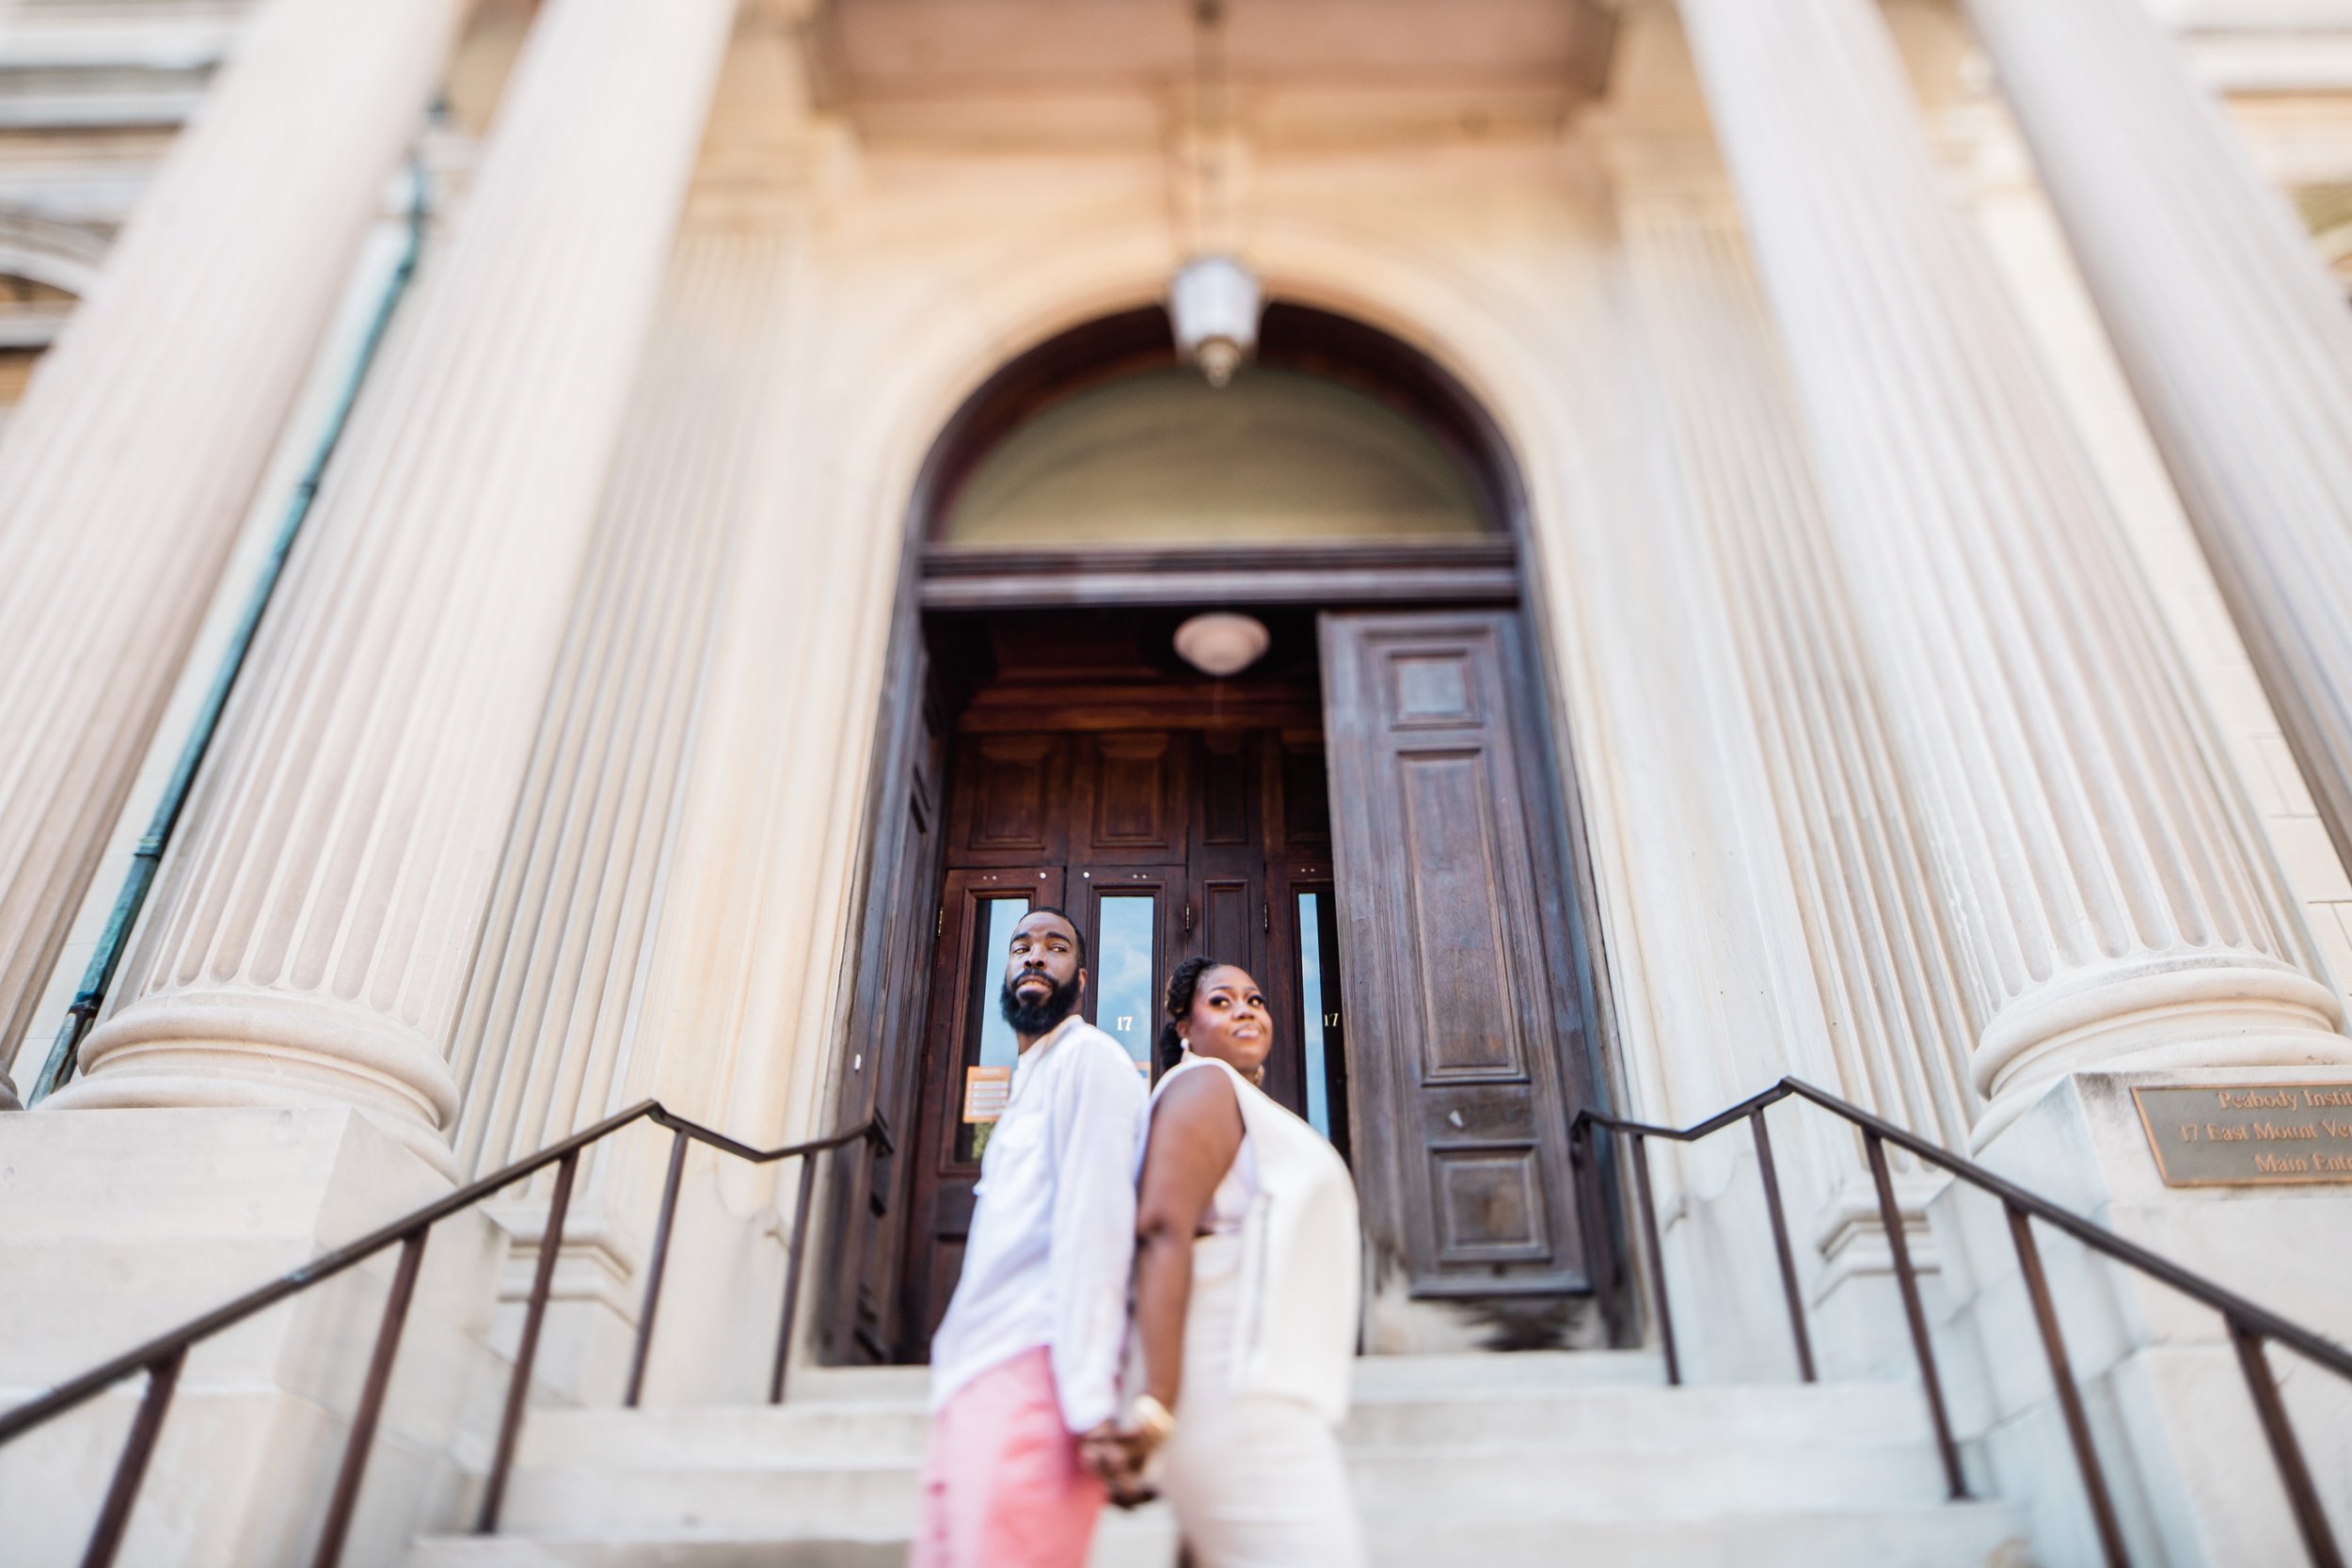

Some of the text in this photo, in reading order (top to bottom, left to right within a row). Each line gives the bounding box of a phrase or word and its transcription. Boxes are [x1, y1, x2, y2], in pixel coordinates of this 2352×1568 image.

[1117, 1016, 1133, 1032] 17
[1324, 1013, 1339, 1027] 17
[2217, 1091, 2297, 1112] Peabody
[2180, 1124, 2198, 1142] 17
[2205, 1122, 2249, 1141] East
[2252, 1121, 2318, 1140] Mount
[2253, 1153, 2308, 1173] Main
